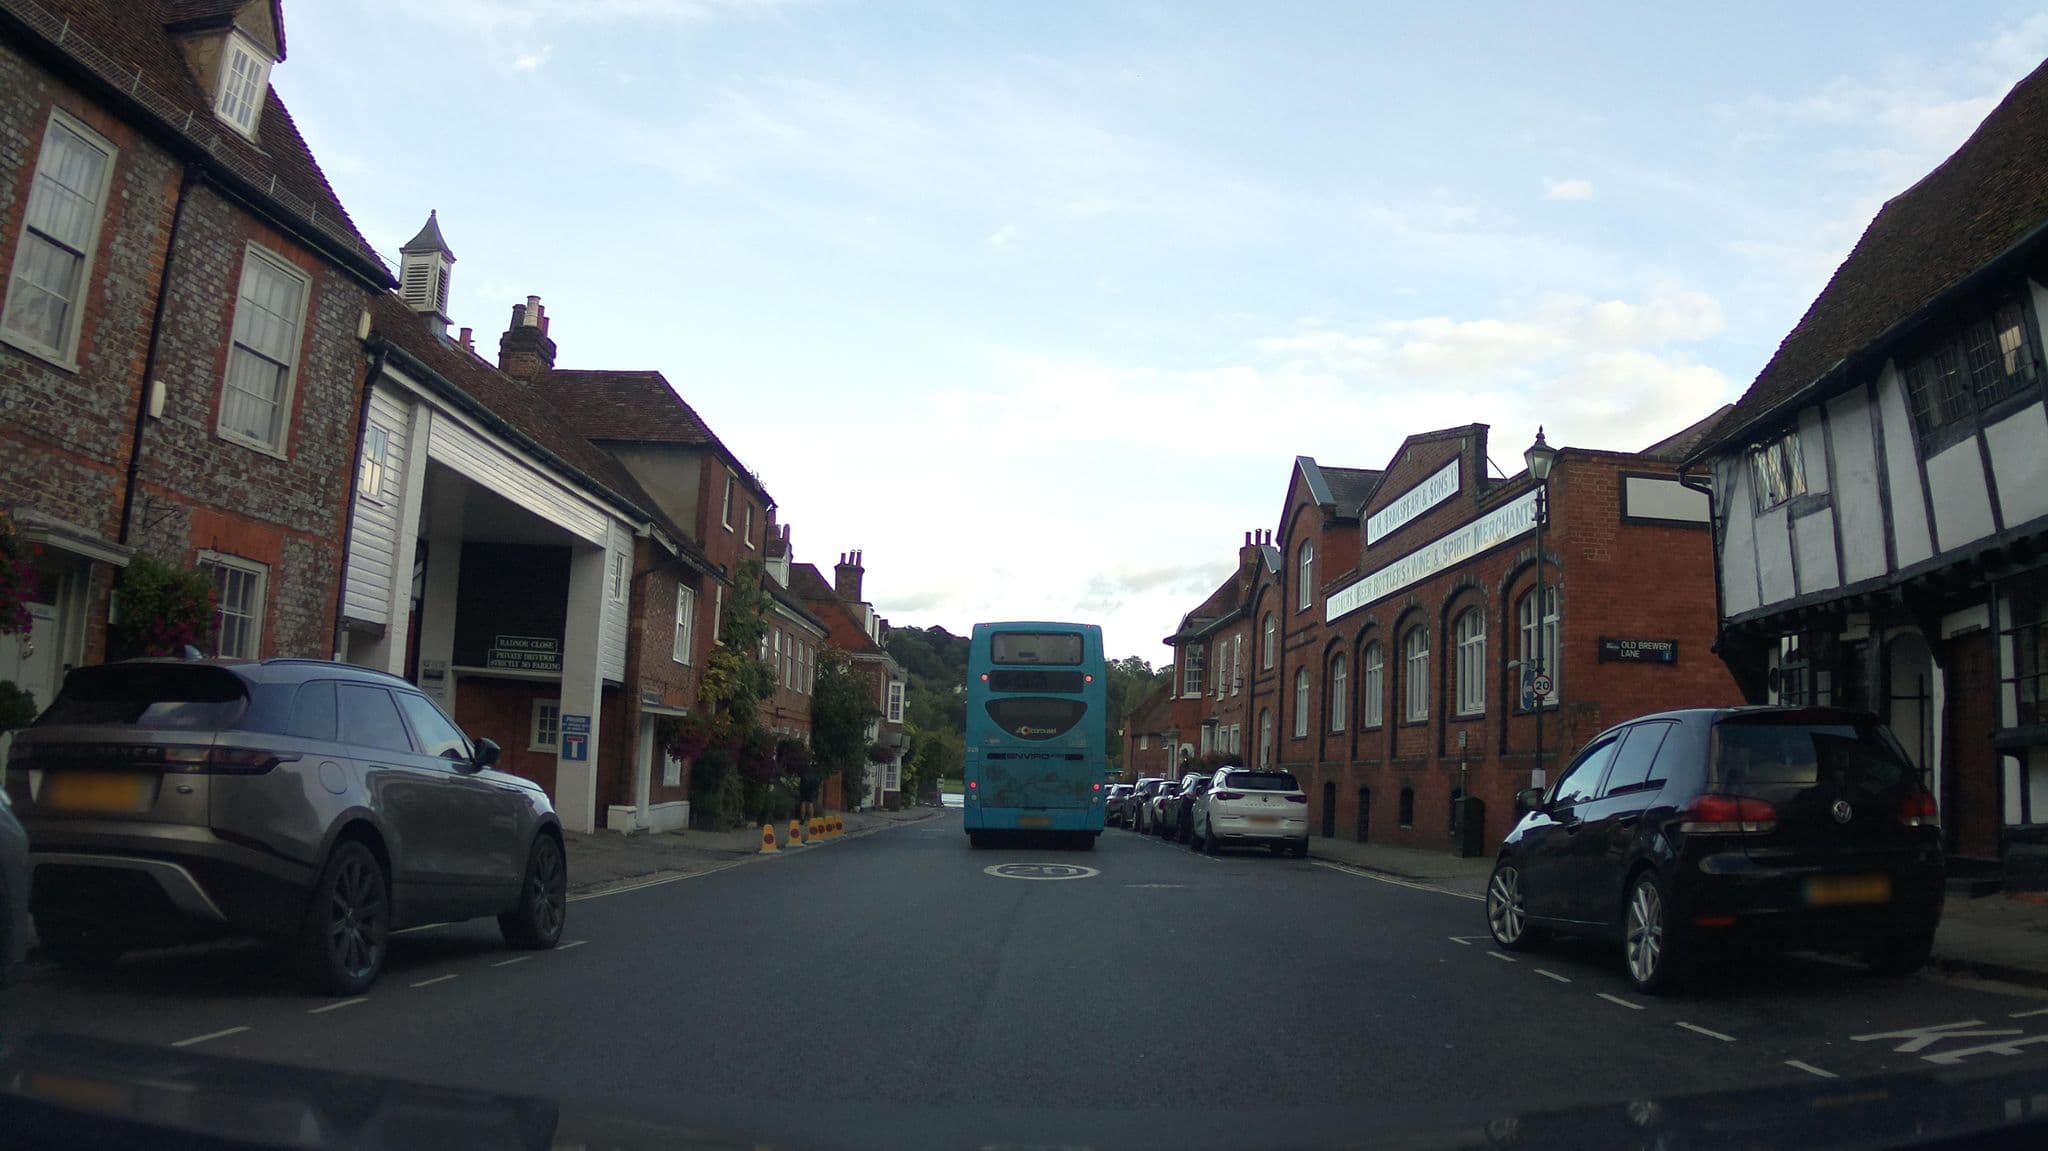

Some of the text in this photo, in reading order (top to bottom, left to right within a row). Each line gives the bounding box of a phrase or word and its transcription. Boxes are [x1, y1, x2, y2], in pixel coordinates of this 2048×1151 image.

[1430, 472, 1448, 504] SONS
[1409, 553, 1431, 577] WINE
[1434, 550, 1439, 566] &
[1443, 532, 1470, 563] SPIRIT
[1474, 499, 1537, 549] MERCHANTS
[530, 641, 554, 649] CLOSE
[1621, 641, 1636, 649] OLD
[1638, 642, 1673, 651] BREWERY
[496, 651, 555, 662] PRIVATE DRIVEWAY
[1621, 650, 1640, 658] LANE
[490, 659, 520, 667] STRICTLY
[532, 662, 561, 670] PARKING
[1535, 681, 1550, 690] 20
